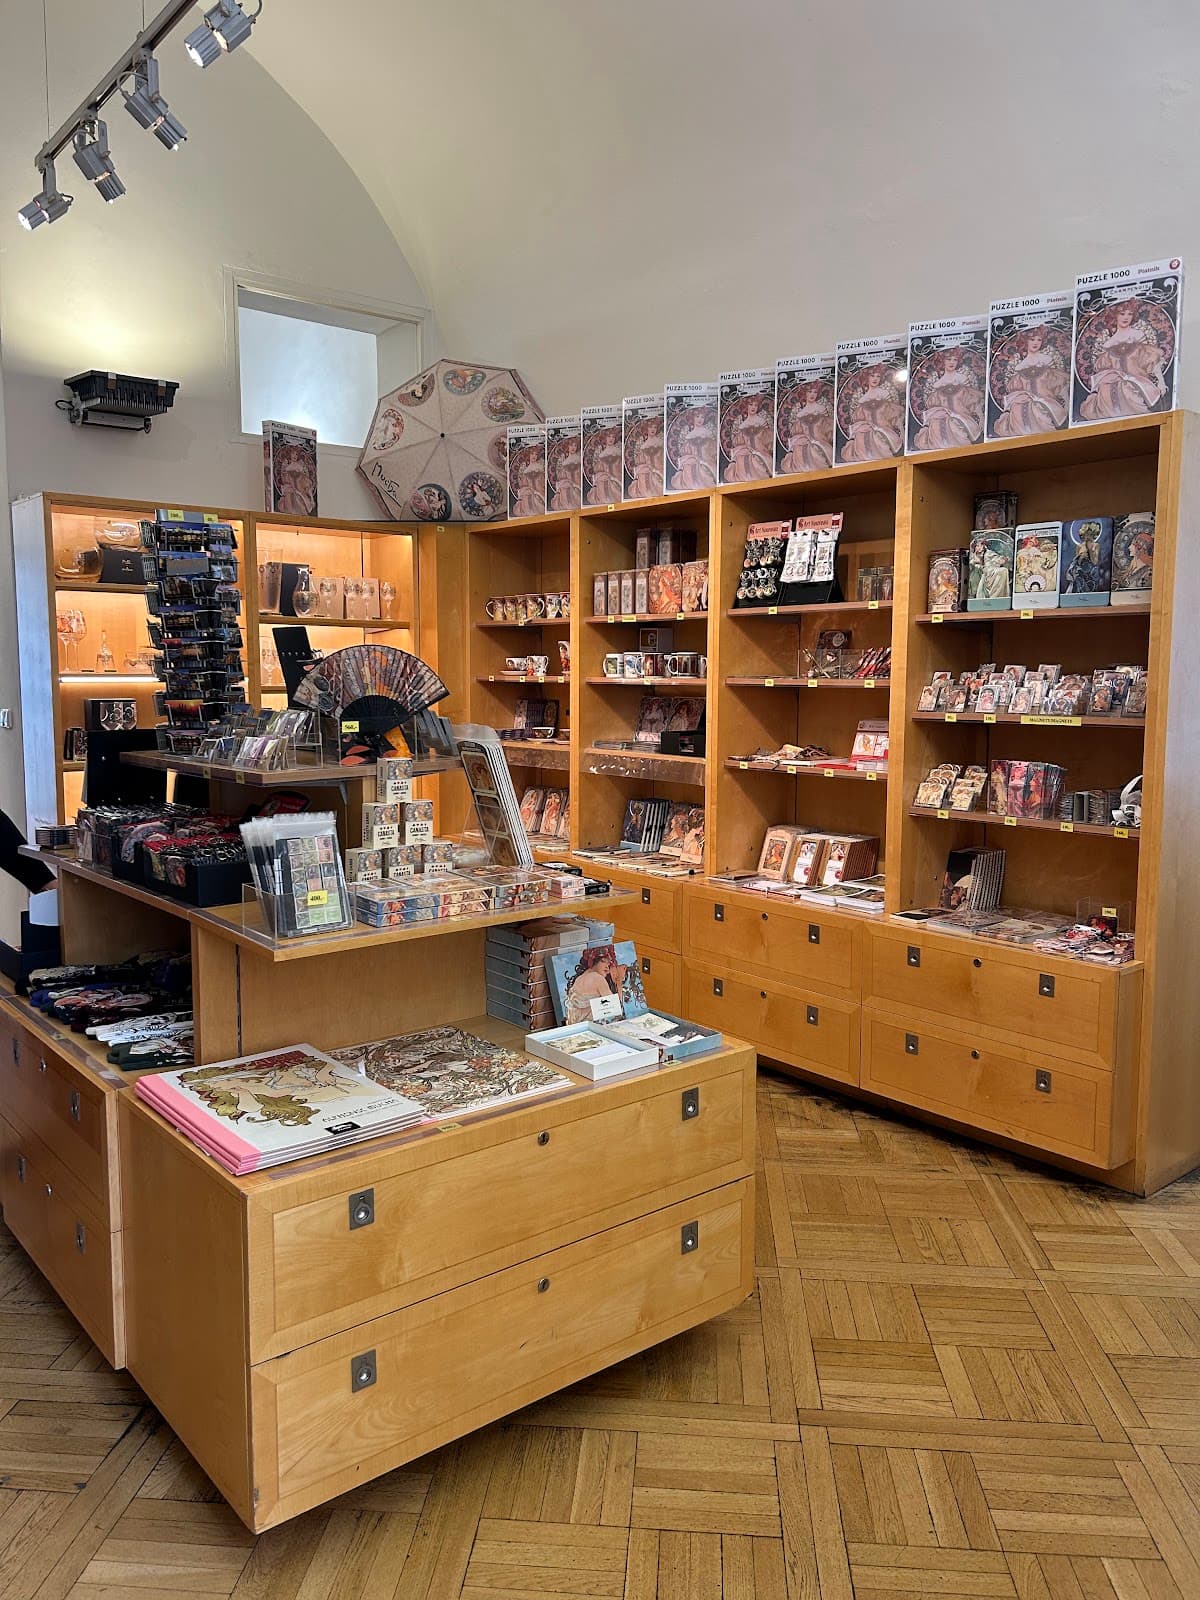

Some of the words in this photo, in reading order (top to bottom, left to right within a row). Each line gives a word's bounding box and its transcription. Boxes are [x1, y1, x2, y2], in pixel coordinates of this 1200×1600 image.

[1077, 274, 1108, 285] PUZZLE
[1110, 269, 1131, 279] 1000
[991, 301, 1020, 311] PUZZLE
[1022, 298, 1040, 307] 1000
[910, 323, 936, 332] PUZZLE
[939, 321, 956, 329] 1000
[837, 342, 861, 350] PUZZLE
[777, 359, 800, 367] PUZZLE
